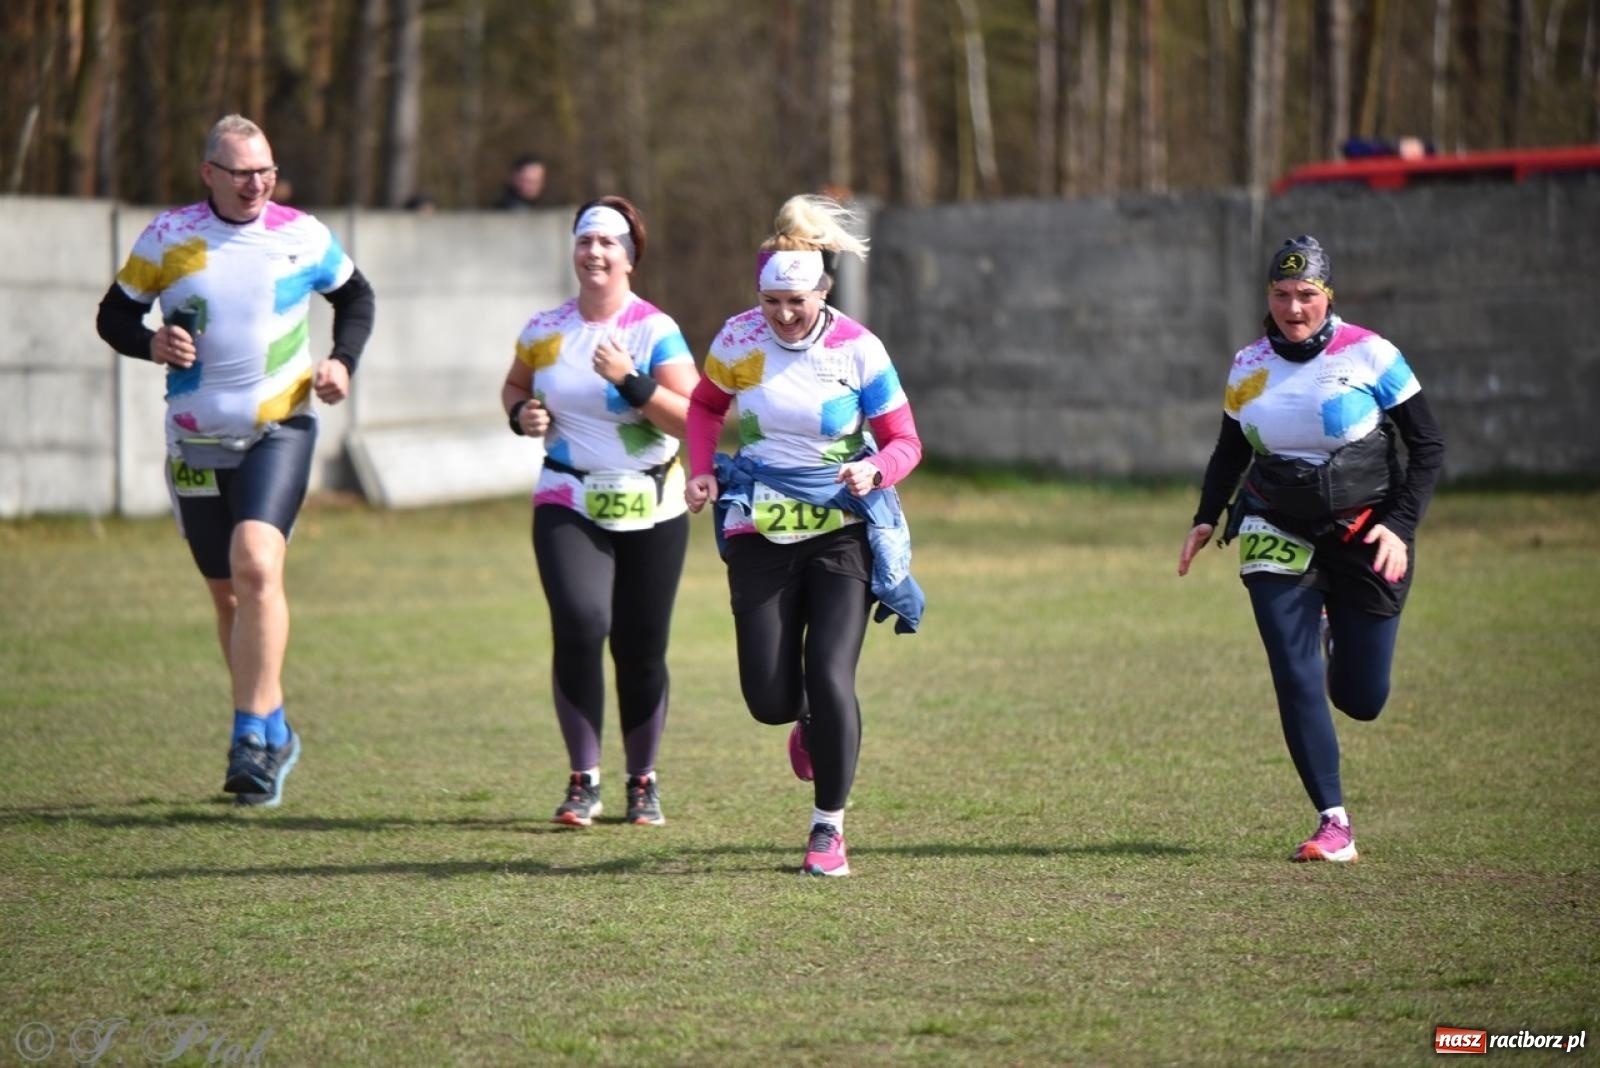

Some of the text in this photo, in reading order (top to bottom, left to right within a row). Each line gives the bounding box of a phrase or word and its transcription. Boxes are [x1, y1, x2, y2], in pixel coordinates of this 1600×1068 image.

[594, 492, 645, 519] 254
[767, 502, 830, 531] 219
[1245, 533, 1299, 564] 225
